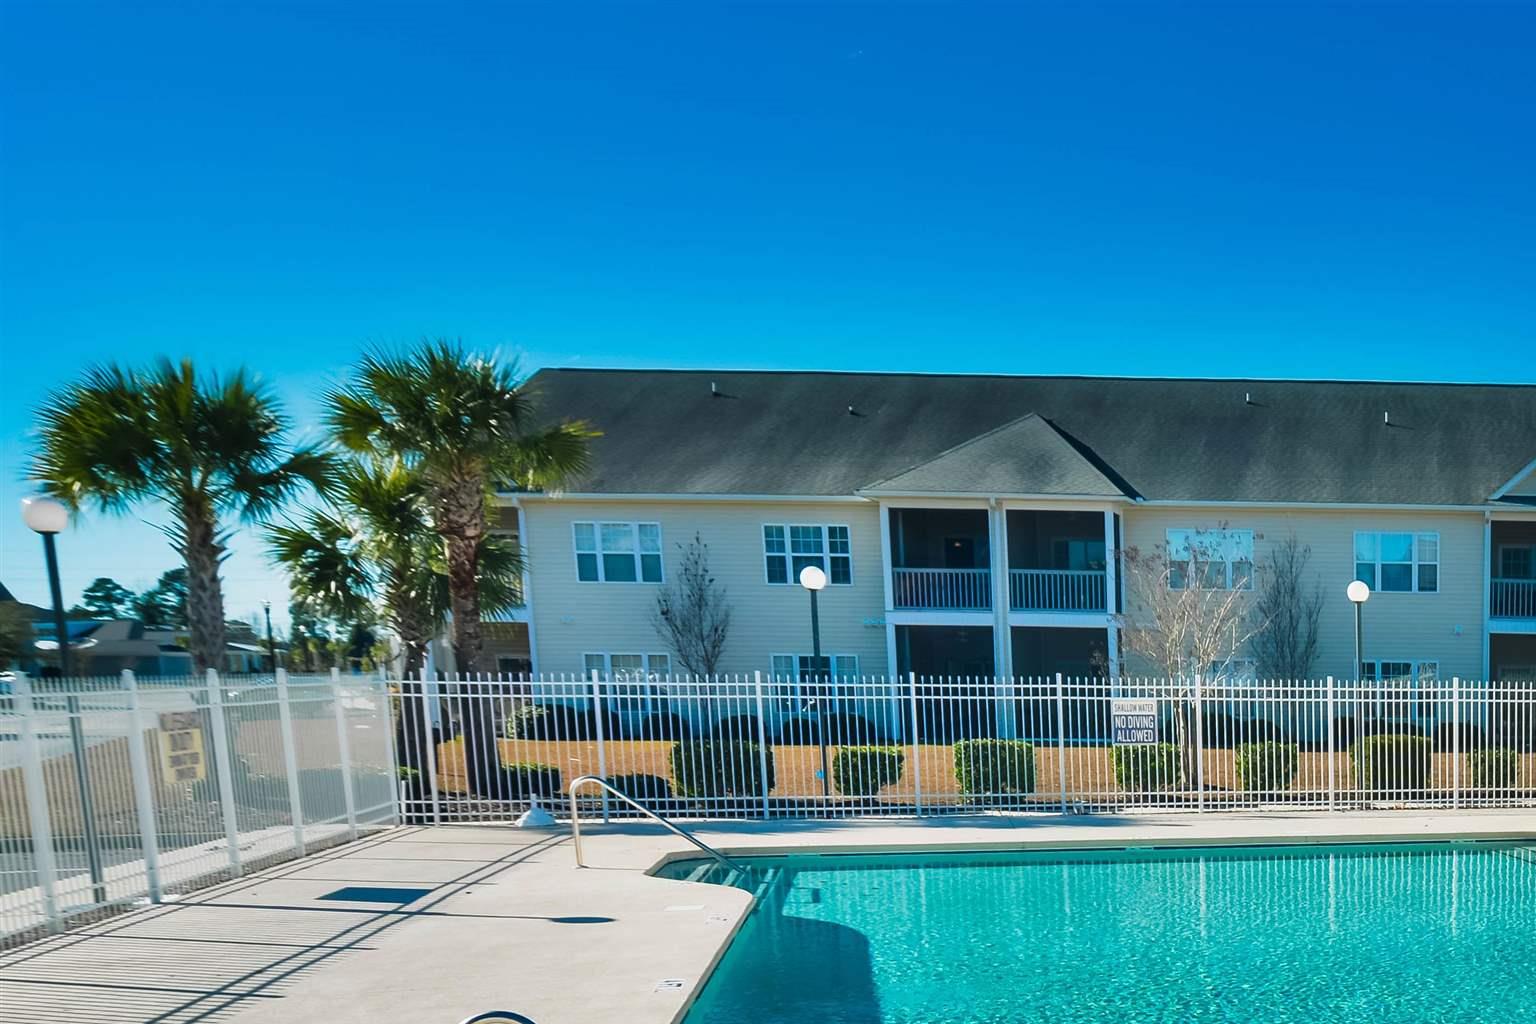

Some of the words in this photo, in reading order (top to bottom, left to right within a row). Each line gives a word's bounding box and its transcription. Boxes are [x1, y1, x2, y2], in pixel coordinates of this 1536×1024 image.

[1114, 703, 1137, 712] SHALLOW
[1137, 703, 1154, 712] WATER
[1115, 715, 1127, 728] NO
[1127, 715, 1154, 728] DIVING
[1116, 729, 1154, 742] ALLOWED
